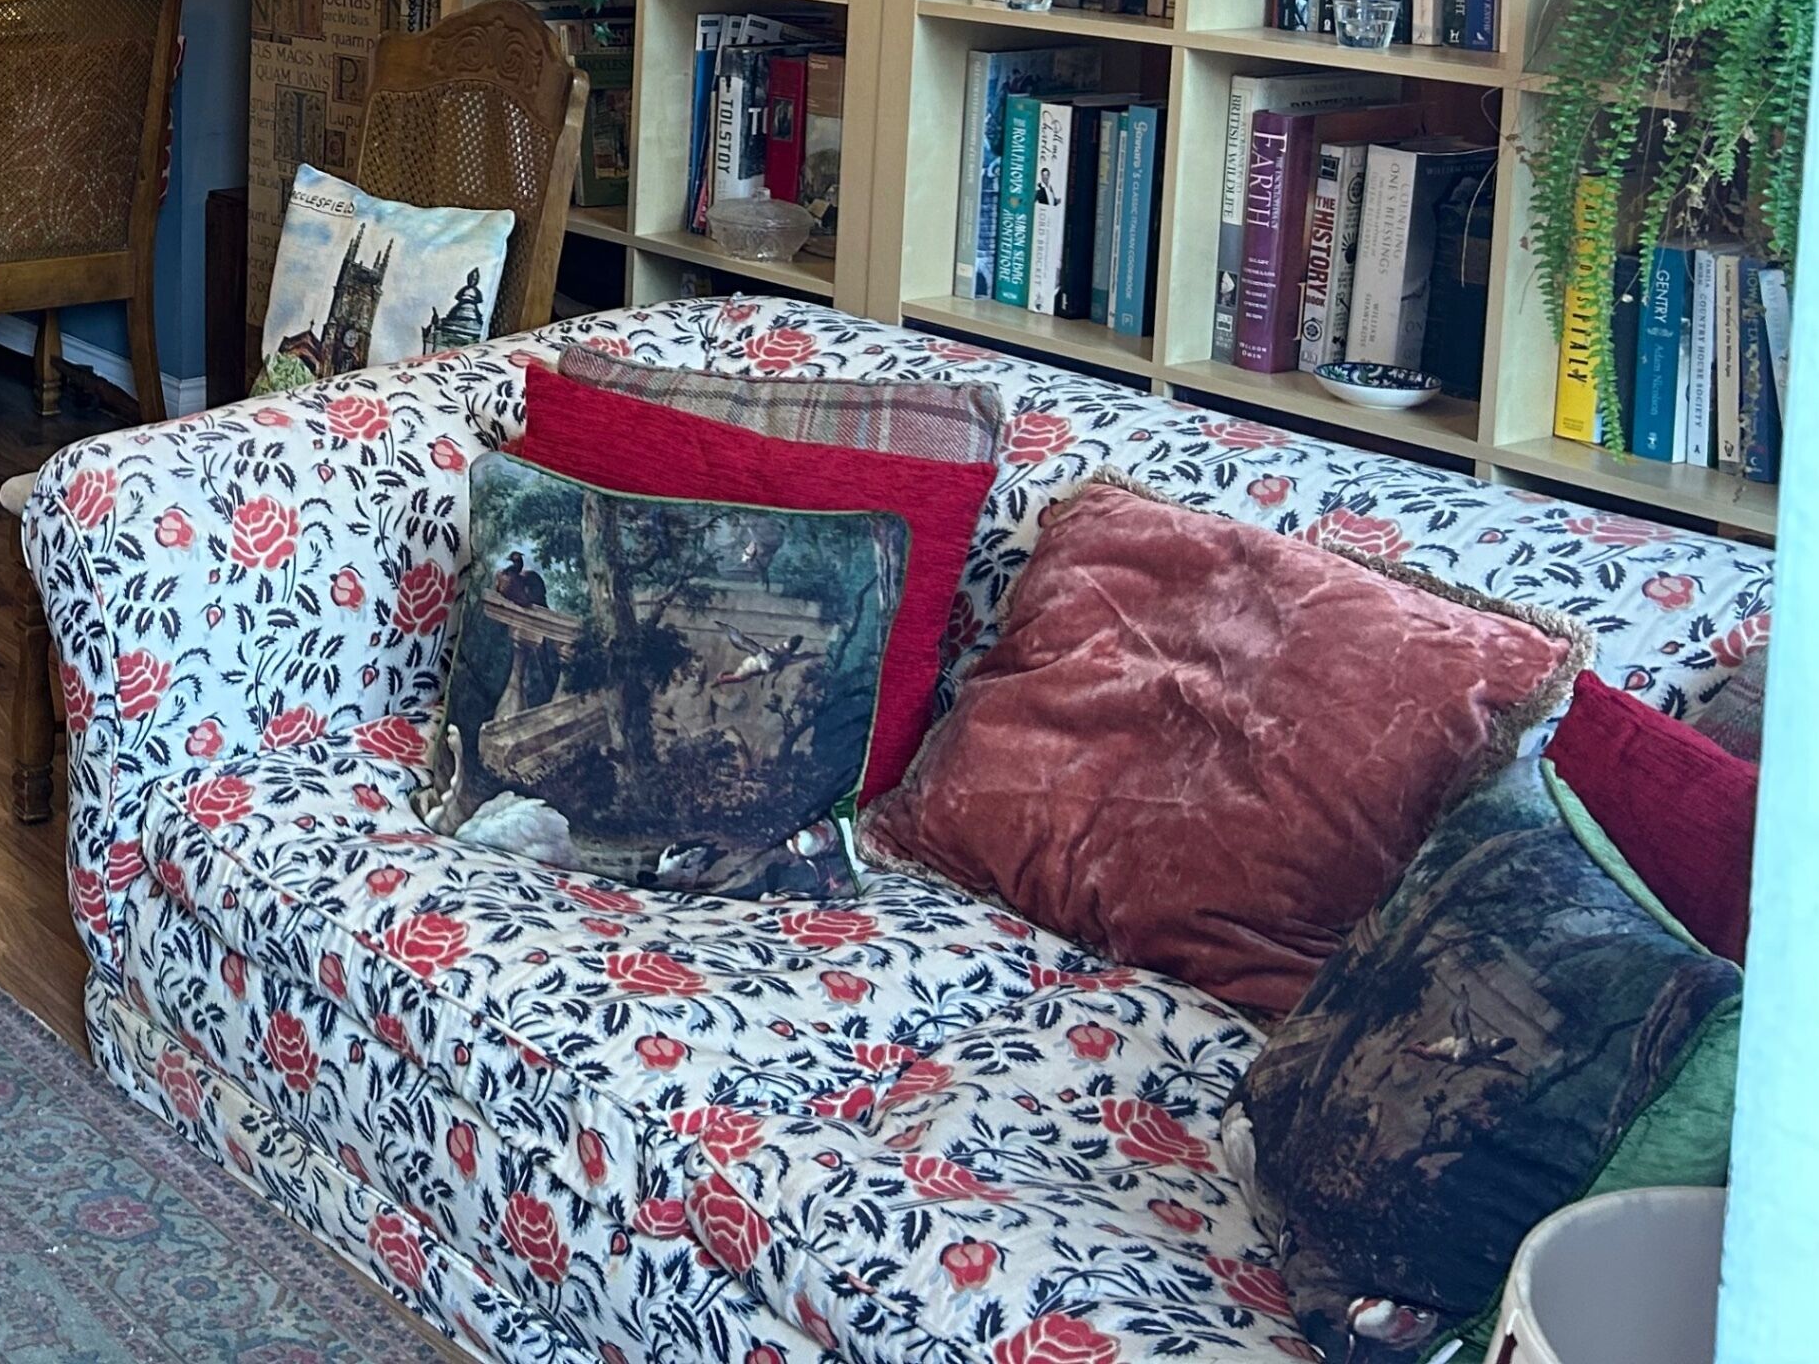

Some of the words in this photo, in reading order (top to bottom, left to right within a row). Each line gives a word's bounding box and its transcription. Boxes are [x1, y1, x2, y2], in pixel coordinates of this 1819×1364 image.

[255, 64, 291, 82] QUAM
[297, 70, 331, 91] IGNIS
[276, 47, 314, 66] MAGIS
[718, 99, 733, 174] TOLSTOY
[1040, 110, 1053, 162] Charlie
[1229, 94, 1241, 150] BRITISH
[1130, 181, 1139, 215] CLASSIC
[1223, 152, 1237, 217] WILDLIFE
[1246, 131, 1288, 227] EARTH
[1387, 162, 1400, 203] ONE'S
[291, 190, 357, 214] ACCLESFIELD
[1315, 197, 1336, 210] THE
[1392, 182, 1411, 260] COUNTING
[999, 209, 1015, 282] MONTEFIORE
[1013, 214, 1027, 246] SIMON
[1128, 216, 1138, 251] ITALIAN
[1377, 206, 1396, 276] BLESSINGS
[1012, 250, 1025, 285] SEBAG
[1307, 211, 1335, 295] HISTORY
[1125, 251, 1135, 301] COOKBOOK
[1654, 269, 1669, 324] GENTRY
[1747, 267, 1757, 296] HOW
[1696, 293, 1707, 342] COUNTRY
[1653, 344, 1664, 372] Adam
[1696, 347, 1705, 379] HOUSE
[1649, 374, 1663, 415] Nicolson
[1695, 383, 1704, 427] SOCIETY
